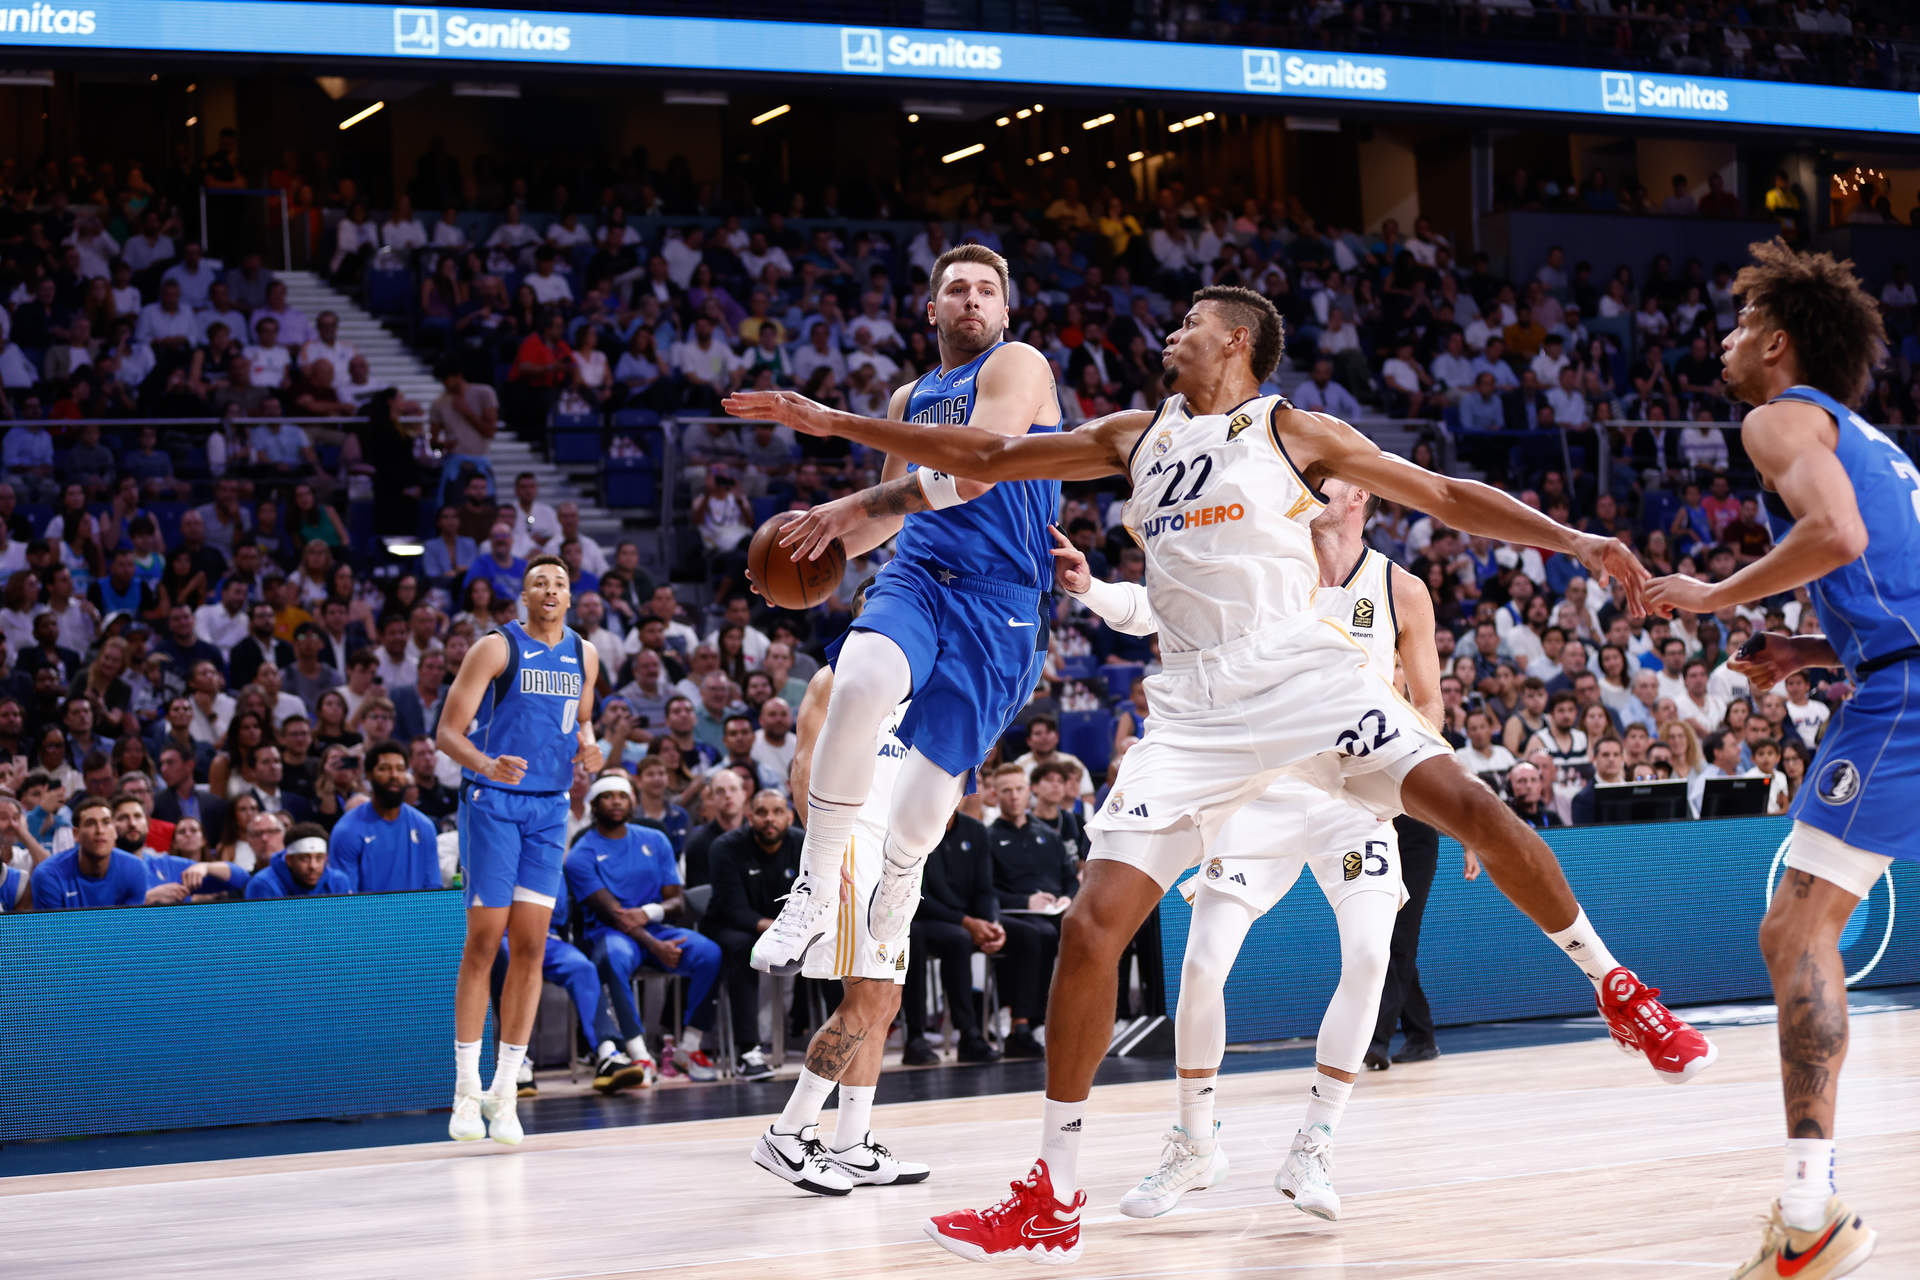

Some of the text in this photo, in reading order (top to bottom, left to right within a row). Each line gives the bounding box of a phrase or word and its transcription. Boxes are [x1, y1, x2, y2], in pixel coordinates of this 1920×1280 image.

[0, 2, 97, 35] nitas
[444, 14, 571, 51] Sanitas
[887, 34, 1003, 70] Sanitas
[1284, 56, 1387, 91] Sanitas
[1638, 79, 1729, 111] Sanitas
[1157, 453, 1213, 508] 22
[1143, 503, 1245, 540] AUTOHERO
[520, 668, 581, 697] DALLAS
[561, 699, 579, 734] 0
[1365, 840, 1389, 876] 5
